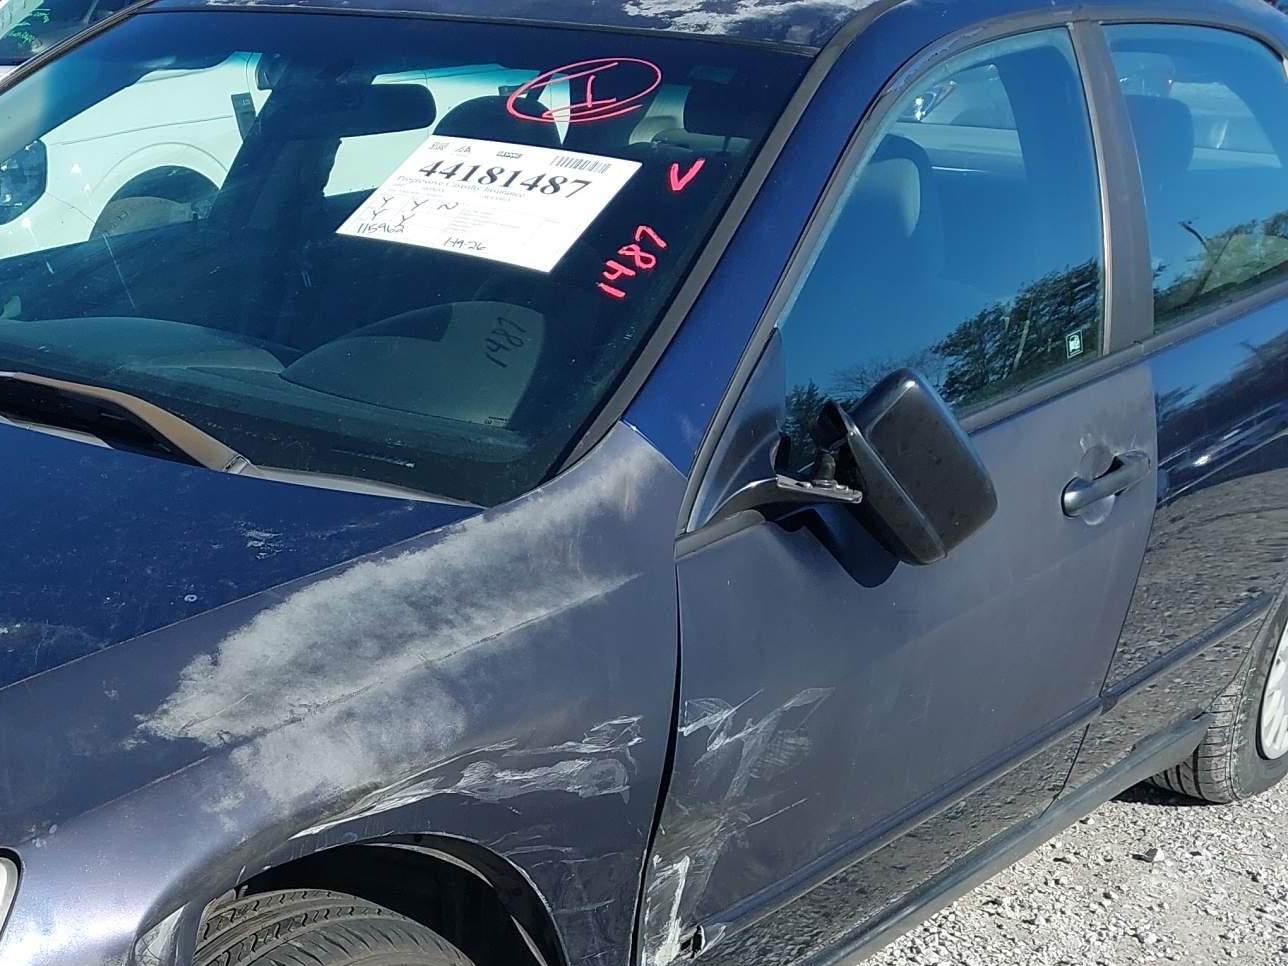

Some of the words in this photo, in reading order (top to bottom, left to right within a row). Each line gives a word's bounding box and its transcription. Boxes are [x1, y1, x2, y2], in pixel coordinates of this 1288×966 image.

[418, 160, 593, 199] 44181487
[598, 224, 668, 299] 1487
[485, 316, 526, 368] 1487
